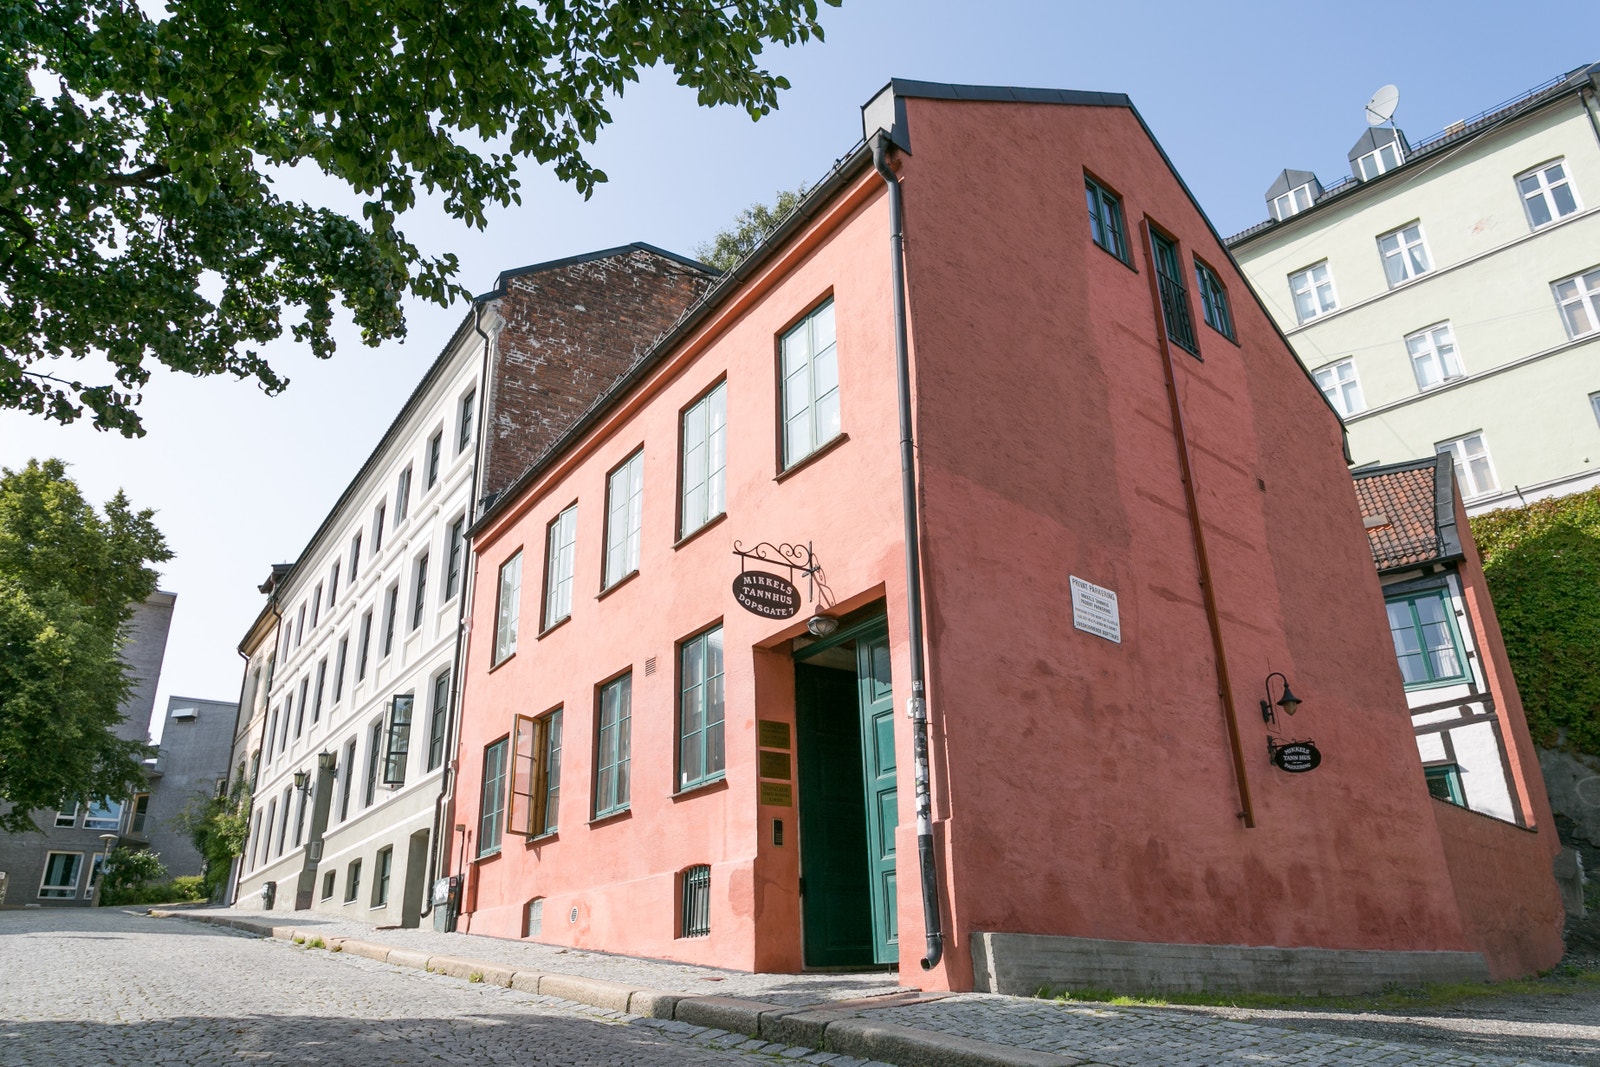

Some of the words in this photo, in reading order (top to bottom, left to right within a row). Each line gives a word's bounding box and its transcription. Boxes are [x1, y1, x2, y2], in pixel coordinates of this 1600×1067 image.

[743, 576, 793, 595] MIKKELS
[1072, 578, 1088, 591] PRIVAT
[1089, 585, 1116, 601] PARKERING
[738, 593, 788, 616] DOPSGATE
[788, 607, 794, 615] 7
[742, 586, 793, 605] TANNHUS
[1283, 746, 1310, 755] MIKKELS
[1283, 762, 1311, 770] PARKERING
